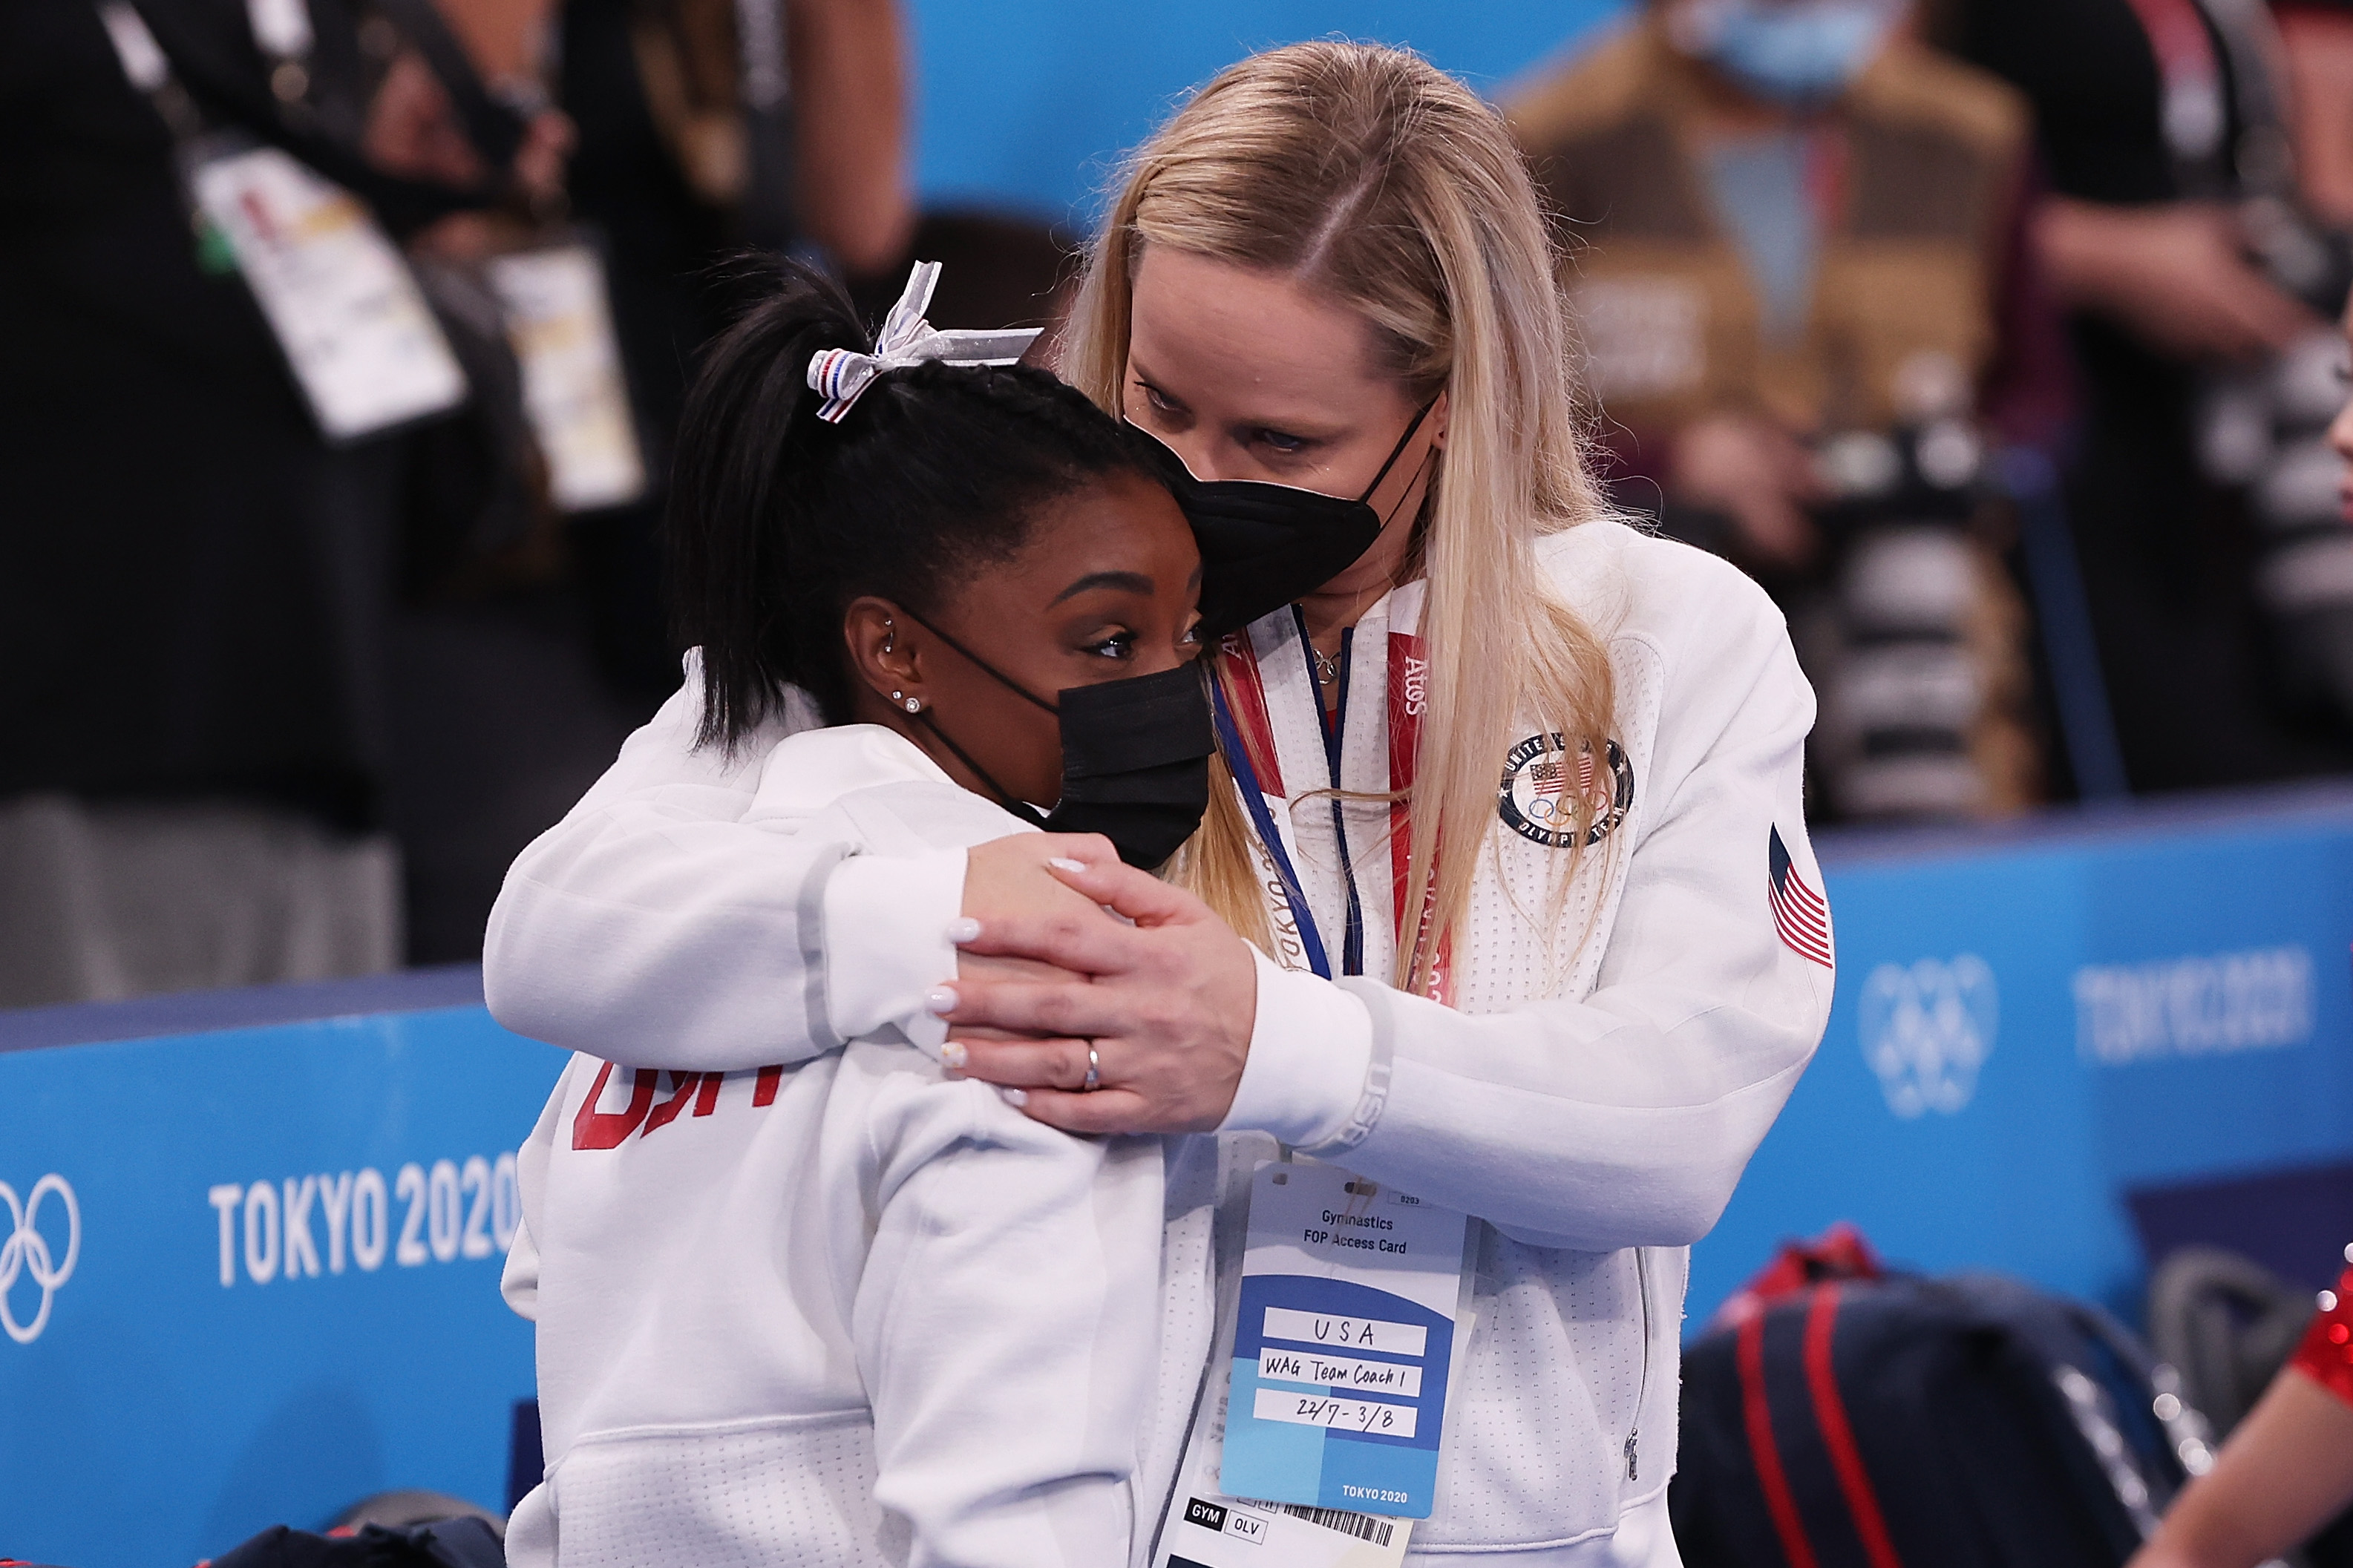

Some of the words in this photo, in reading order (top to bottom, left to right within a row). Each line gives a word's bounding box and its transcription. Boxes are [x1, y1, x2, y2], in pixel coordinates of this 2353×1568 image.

[1405, 656, 1428, 715] Atos
[1505, 739, 1544, 771] UNITE
[209, 1167, 389, 1288] TOKYO
[396, 1150, 520, 1267] 2020
[1322, 1210, 1393, 1230] Gymnastics
[1303, 1229, 1328, 1244] FOP
[1332, 1234, 1375, 1250] Access
[1379, 1239, 1407, 1254] Card
[1266, 1357, 1300, 1377] WAG
[1310, 1360, 1348, 1381] Team
[1354, 1364, 1393, 1385] Coach
[1343, 1485, 1379, 1500] TOKYO
[1381, 1488, 1408, 1503] 2020
[1191, 1504, 1221, 1523] GYM
[1234, 1518, 1260, 1535] OLV
